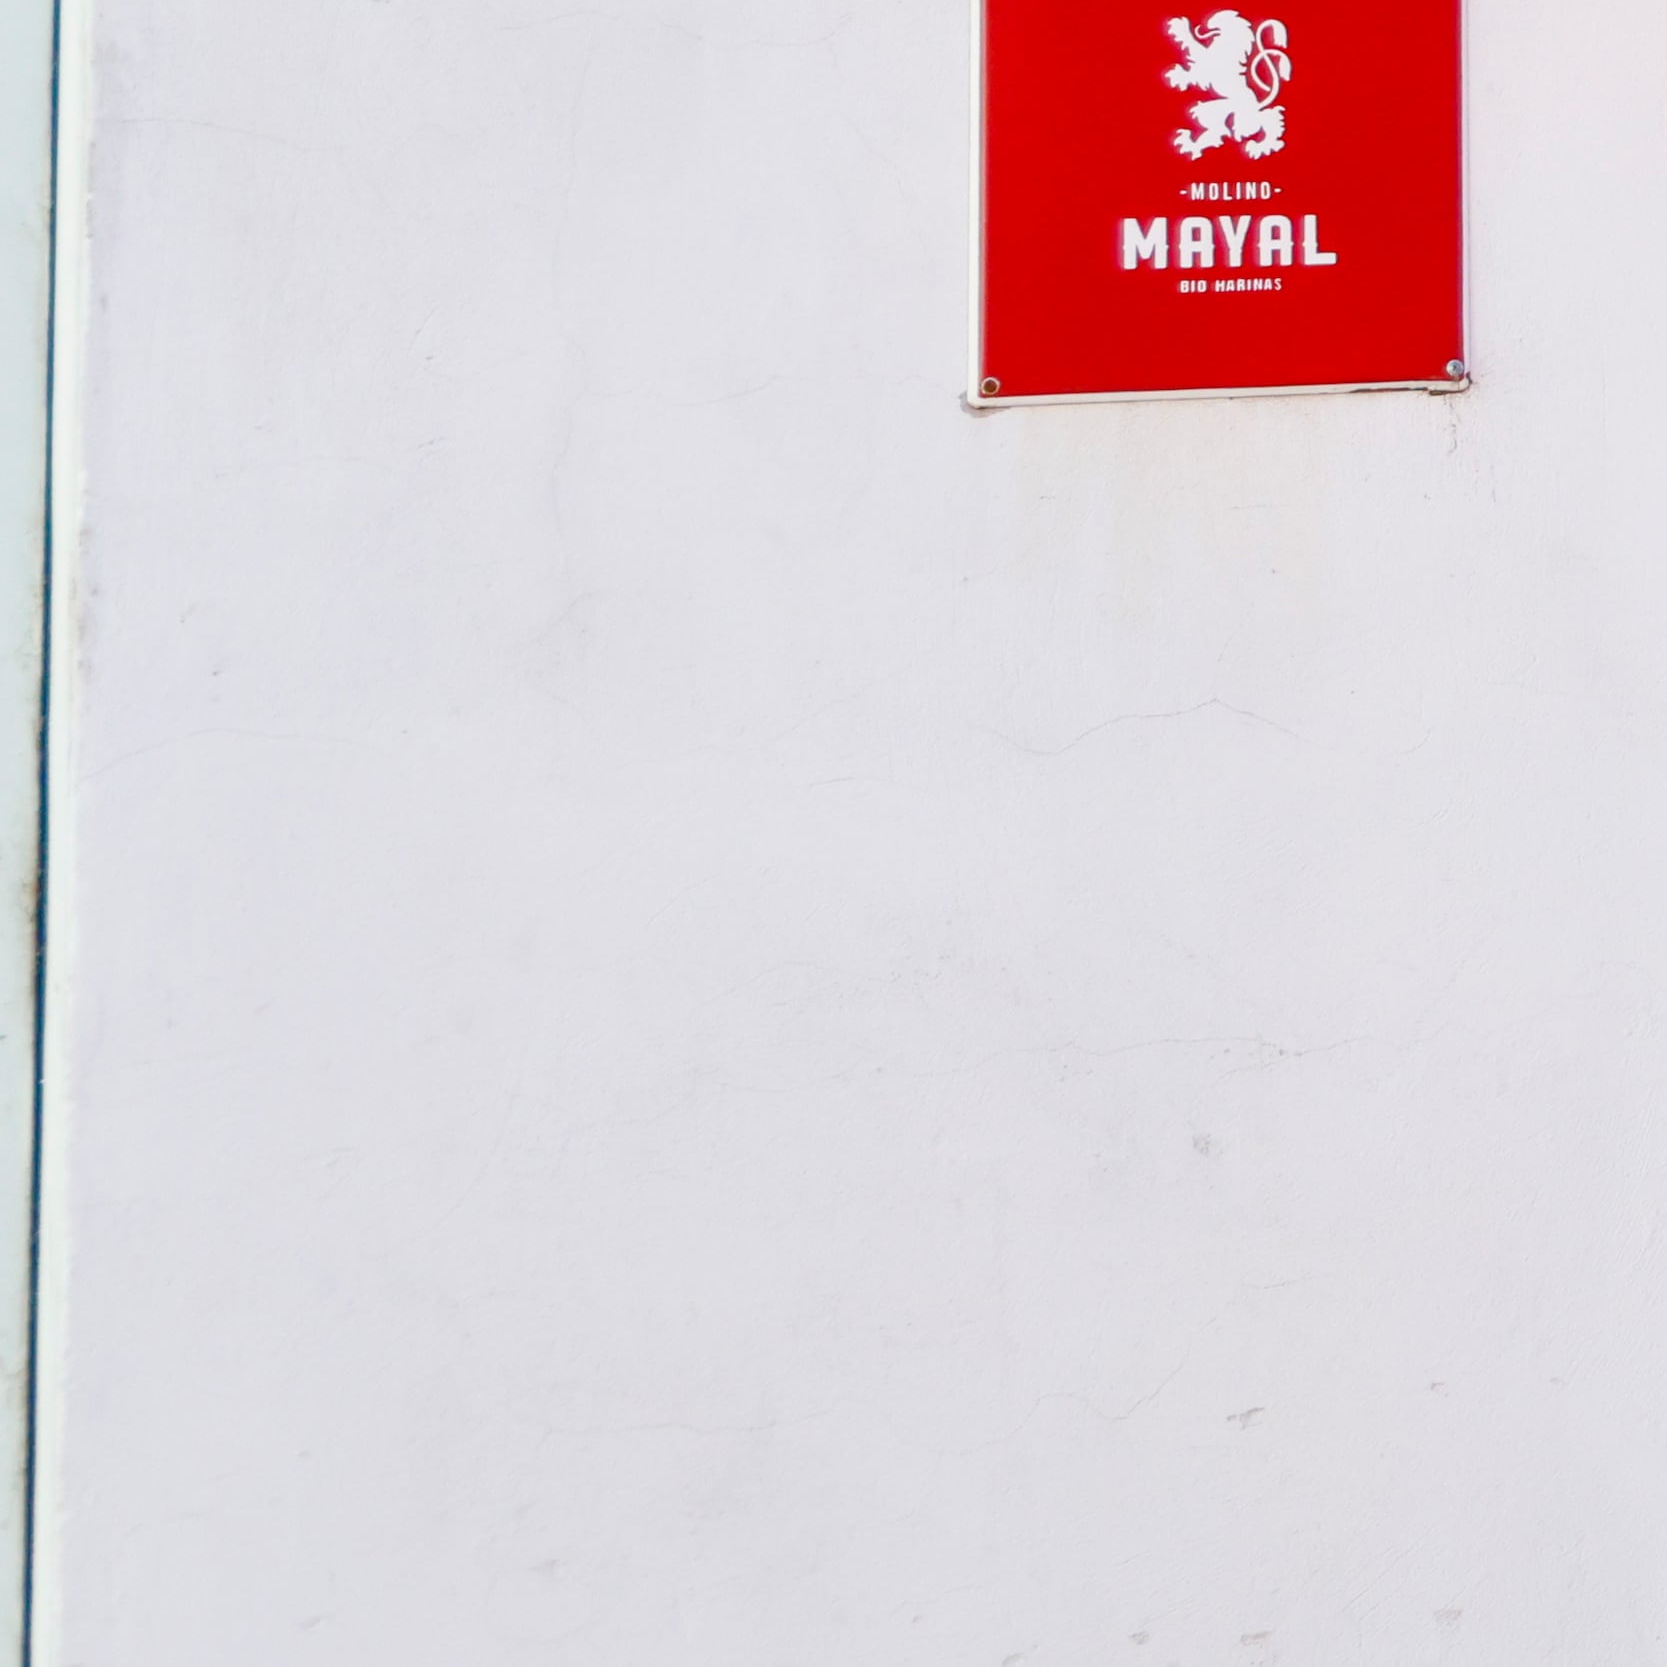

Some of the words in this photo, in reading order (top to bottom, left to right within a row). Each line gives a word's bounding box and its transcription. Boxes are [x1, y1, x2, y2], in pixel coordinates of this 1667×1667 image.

[1121, 214, 1337, 270] MAYAL
[1179, 279, 1207, 293] BIO
[1215, 277, 1283, 292] HARINAS
